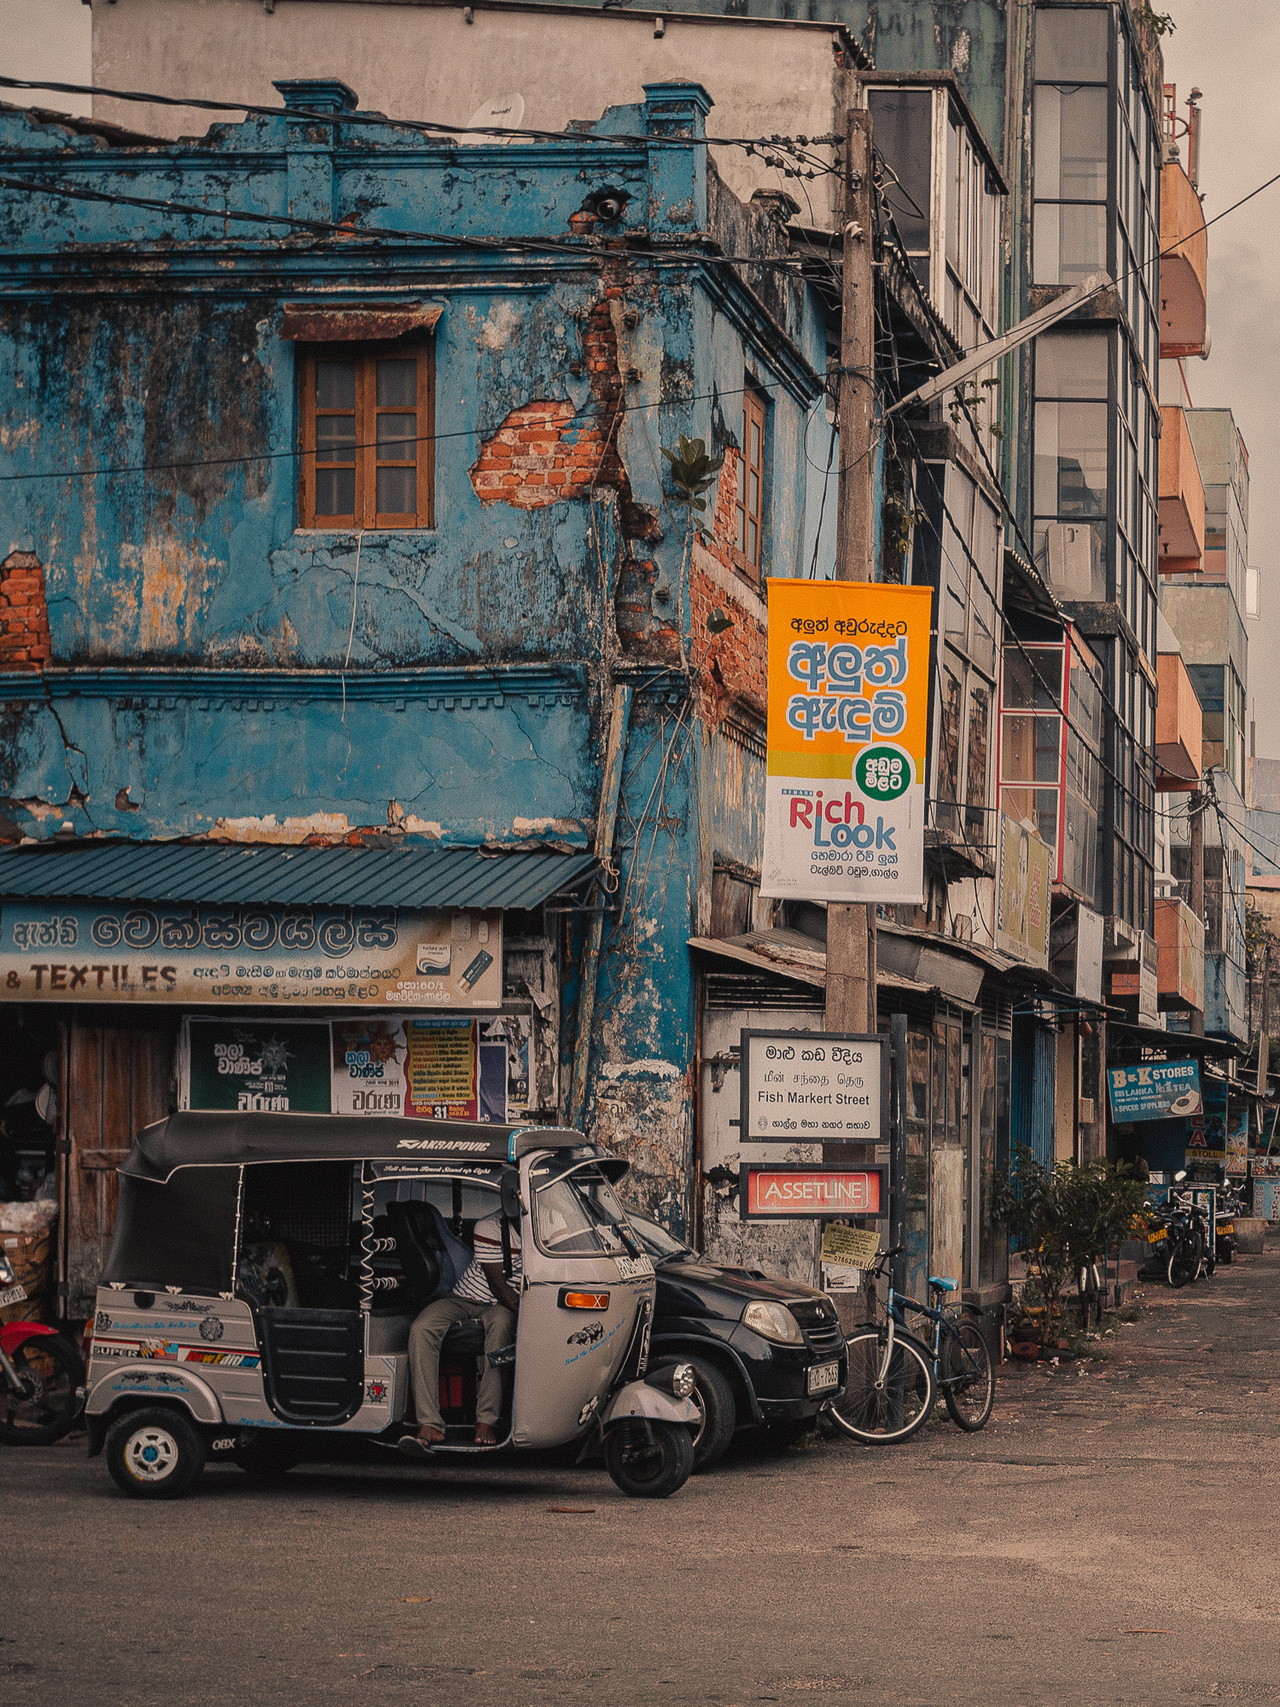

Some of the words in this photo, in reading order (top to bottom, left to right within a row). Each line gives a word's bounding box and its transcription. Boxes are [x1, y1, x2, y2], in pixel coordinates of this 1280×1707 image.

[791, 617, 829, 634] අලුත්
[834, 618, 908, 638] අවුරුද්දට
[787, 636, 909, 695] අලුත්
[790, 790, 865, 829] Rich
[814, 816, 897, 850] Look
[811, 850, 853, 862] හෙමාරා
[6, 970, 21, 990] &
[30, 964, 178, 991] TEXTILES
[214, 1043, 244, 1061] කලා
[346, 1051, 370, 1066] කලා
[801, 1047, 826, 1061] කඩ
[831, 1047, 863, 1065] වීදිය
[764, 1070, 785, 1083] மீன்
[792, 1072, 829, 1087] சந்தை
[837, 1073, 864, 1088] தெரு
[1152, 1066, 1194, 1080] STORES
[758, 1091, 783, 1103] Fish
[788, 1092, 832, 1104] Markert
[836, 1093, 870, 1105] Street
[1126, 1088, 1153, 1097] LANKA
[1173, 1083, 1191, 1092] TEA
[434, 1106, 448, 1119] 31
[1119, 1104, 1139, 1112] SPICES
[772, 1118, 797, 1129] ගාල්ල
[801, 1119, 819, 1128] මහා
[822, 1120, 843, 1129] නගර
[764, 1182, 862, 1200] ASSETLINE
[94, 1345, 138, 1357] SUPER
